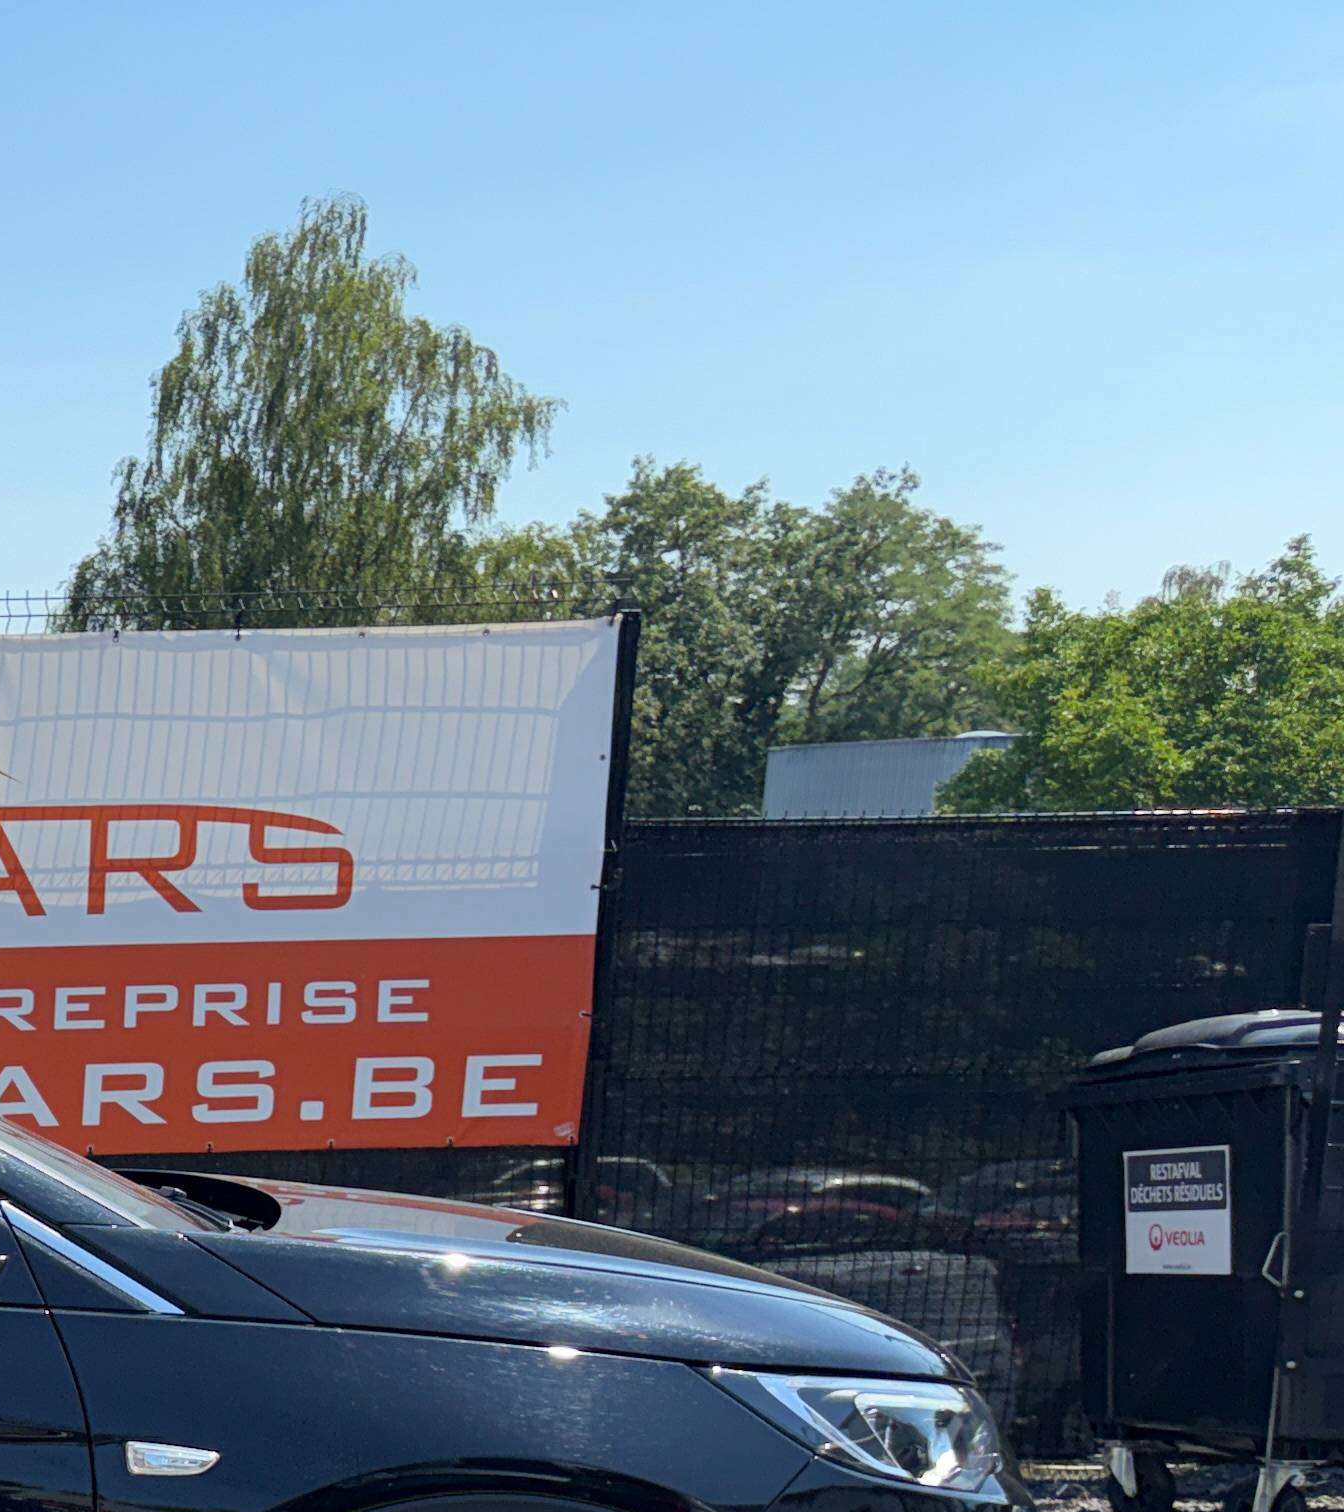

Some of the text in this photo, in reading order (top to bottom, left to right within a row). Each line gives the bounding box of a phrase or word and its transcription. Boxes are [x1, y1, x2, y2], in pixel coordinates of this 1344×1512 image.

[1149, 1161, 1203, 1181] RESTAFVAL
[1130, 1181, 1224, 1204] DÉCHETS RÉSIDUELS
[1164, 1230, 1206, 1246] VEOLIA
